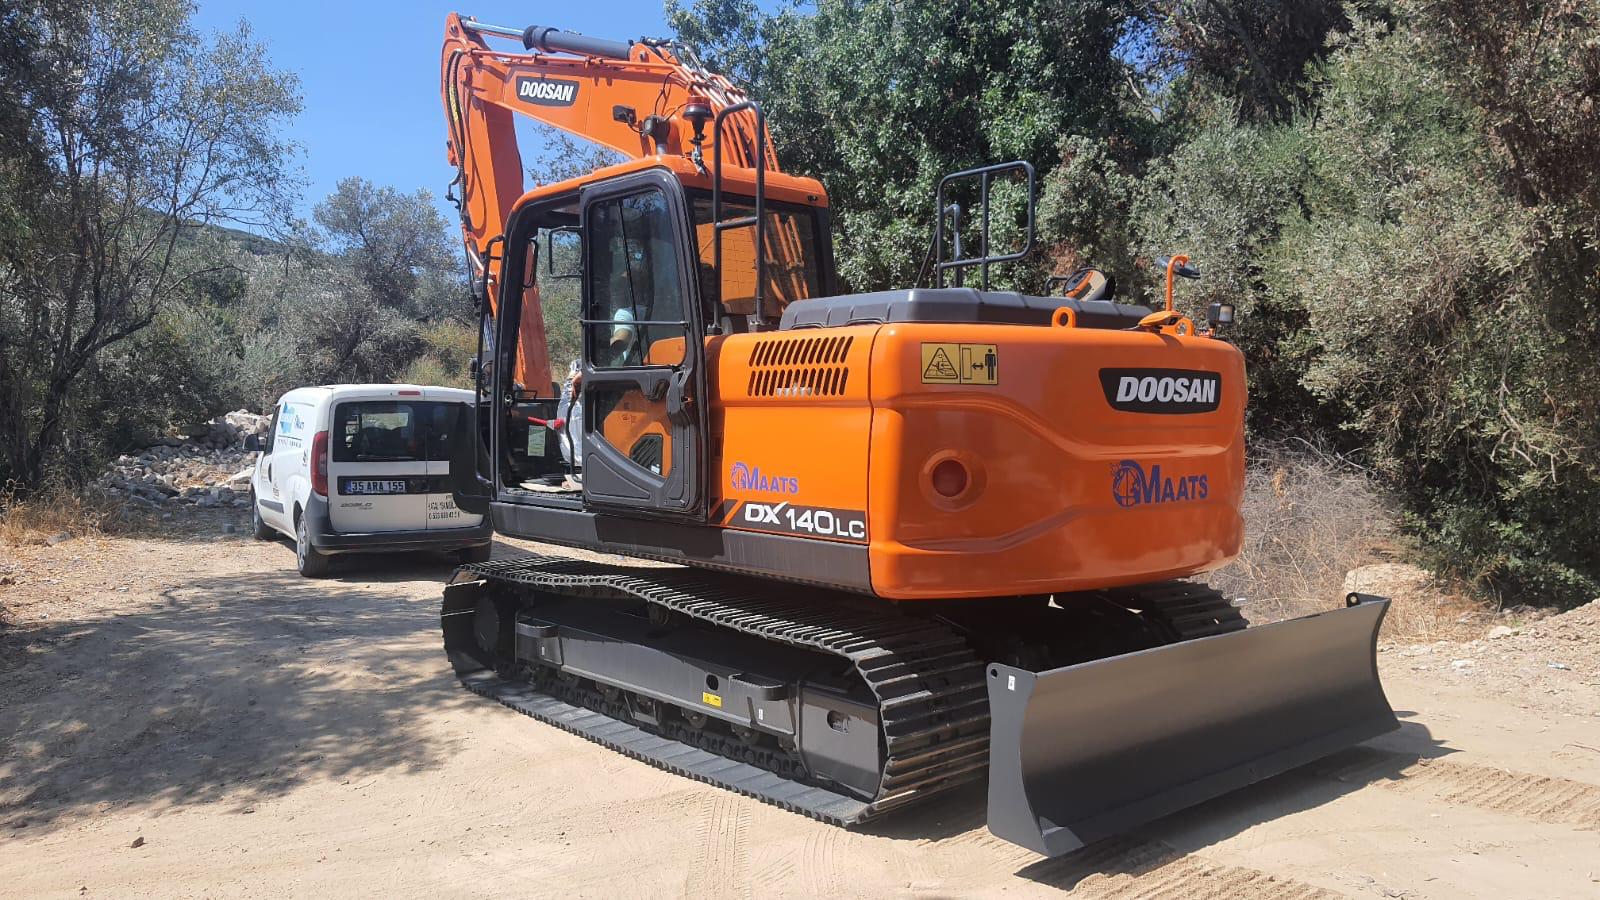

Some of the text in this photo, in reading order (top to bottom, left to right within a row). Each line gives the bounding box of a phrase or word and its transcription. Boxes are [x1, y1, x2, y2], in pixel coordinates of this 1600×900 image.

[520, 81, 574, 102] DOOSAN
[1116, 376, 1216, 403] DOOSAN
[352, 481, 404, 491] 35 ARA 155
